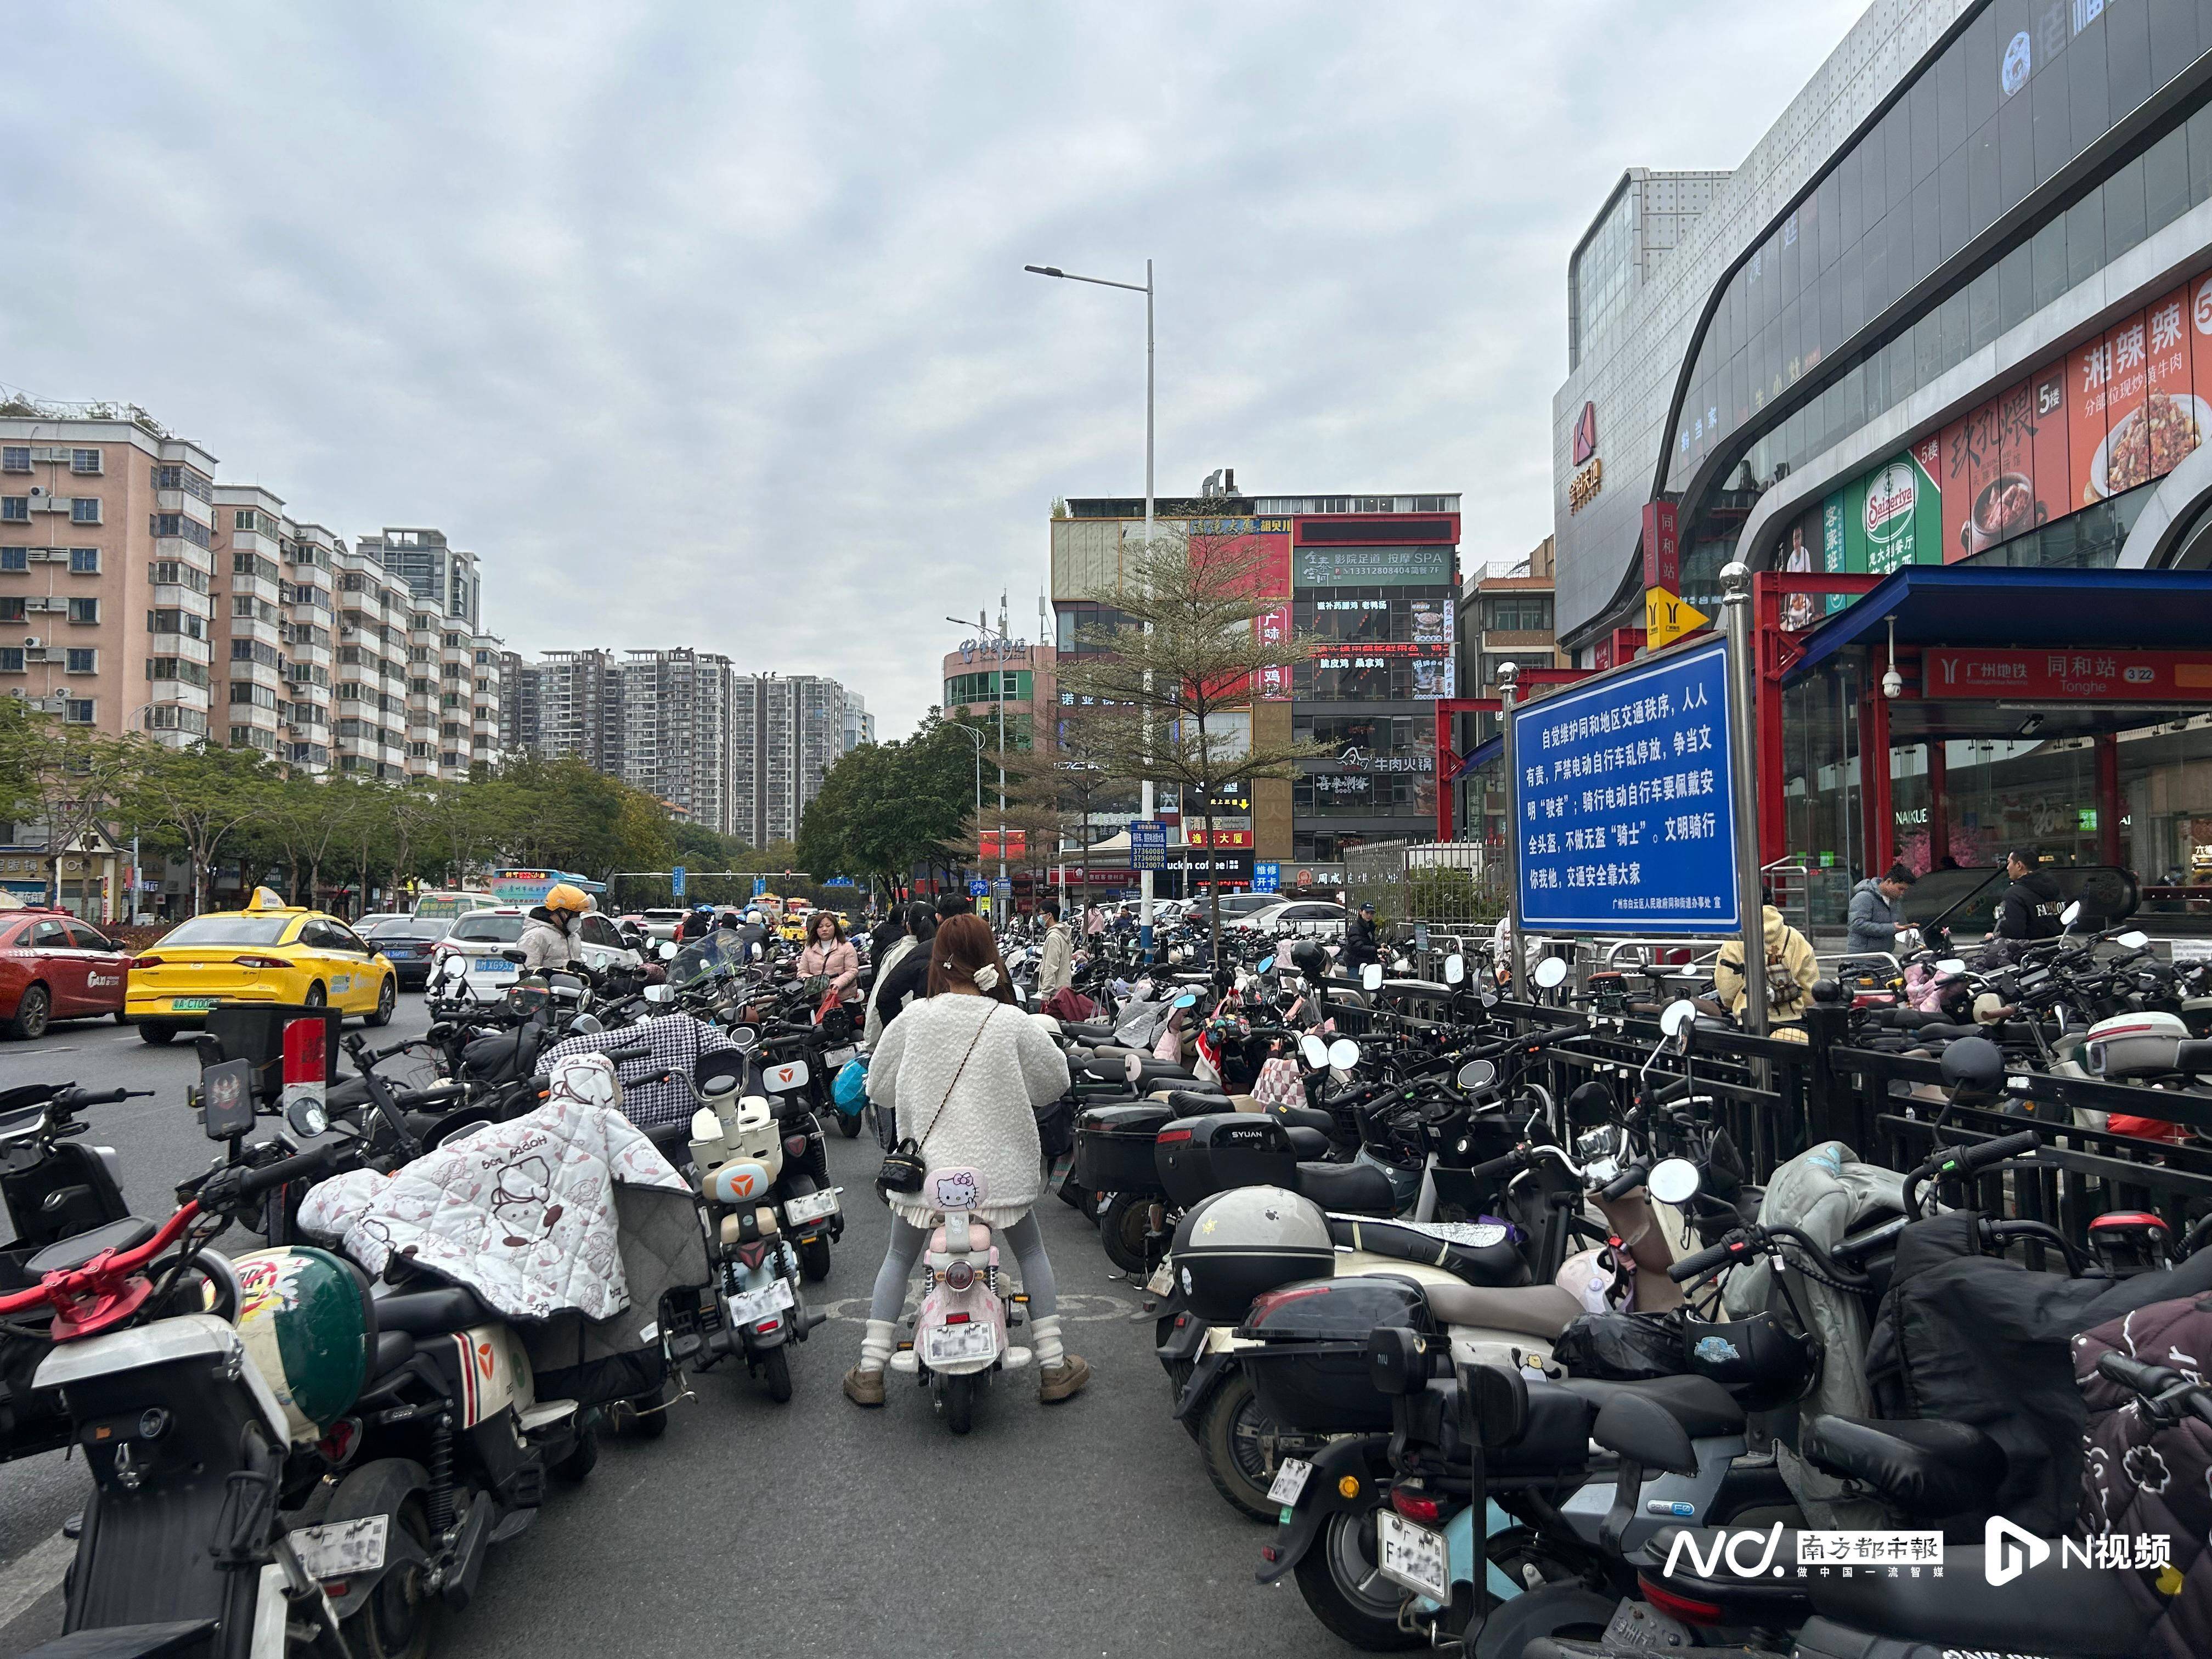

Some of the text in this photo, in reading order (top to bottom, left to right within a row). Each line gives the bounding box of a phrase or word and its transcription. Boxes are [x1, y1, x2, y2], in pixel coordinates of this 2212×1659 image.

[2083, 302, 2182, 393] 湘辣辣
[2085, 352, 2182, 419] 分部位现炒黄牛肉
[2039, 384, 2060, 413] 5楼
[1921, 439, 1938, 464] 5楼
[1867, 487, 1912, 530] Saizeriya
[1661, 514, 1674, 580] 同和站
[1826, 505, 1838, 573] 客家班
[1869, 534, 1914, 567] 意大利餐厅
[1334, 552, 1442, 565] 影院足道 按摩 SPA
[1966, 656, 2116, 679] 广州地铁 同和站
[2140, 670, 2152, 680] 22
[2059, 680, 2107, 694] Tonghe
[1542, 682, 1707, 750] 自觉维护同和地区交通秩序，人人
[1375, 758, 1432, 771] 牛肉火锅
[1526, 724, 1712, 787] 有责，严禁电动自行车乱停放，争当文
[1895, 808, 1927, 825] NAIXUE
[1195, 860, 1225, 870] cofee
[1256, 866, 1277, 875] 维修
[1530, 861, 1640, 890] 你我他，交通安全靠大家
[1256, 877, 1277, 887] 开卡
[1232, 1131, 1263, 1139] SYUAN
